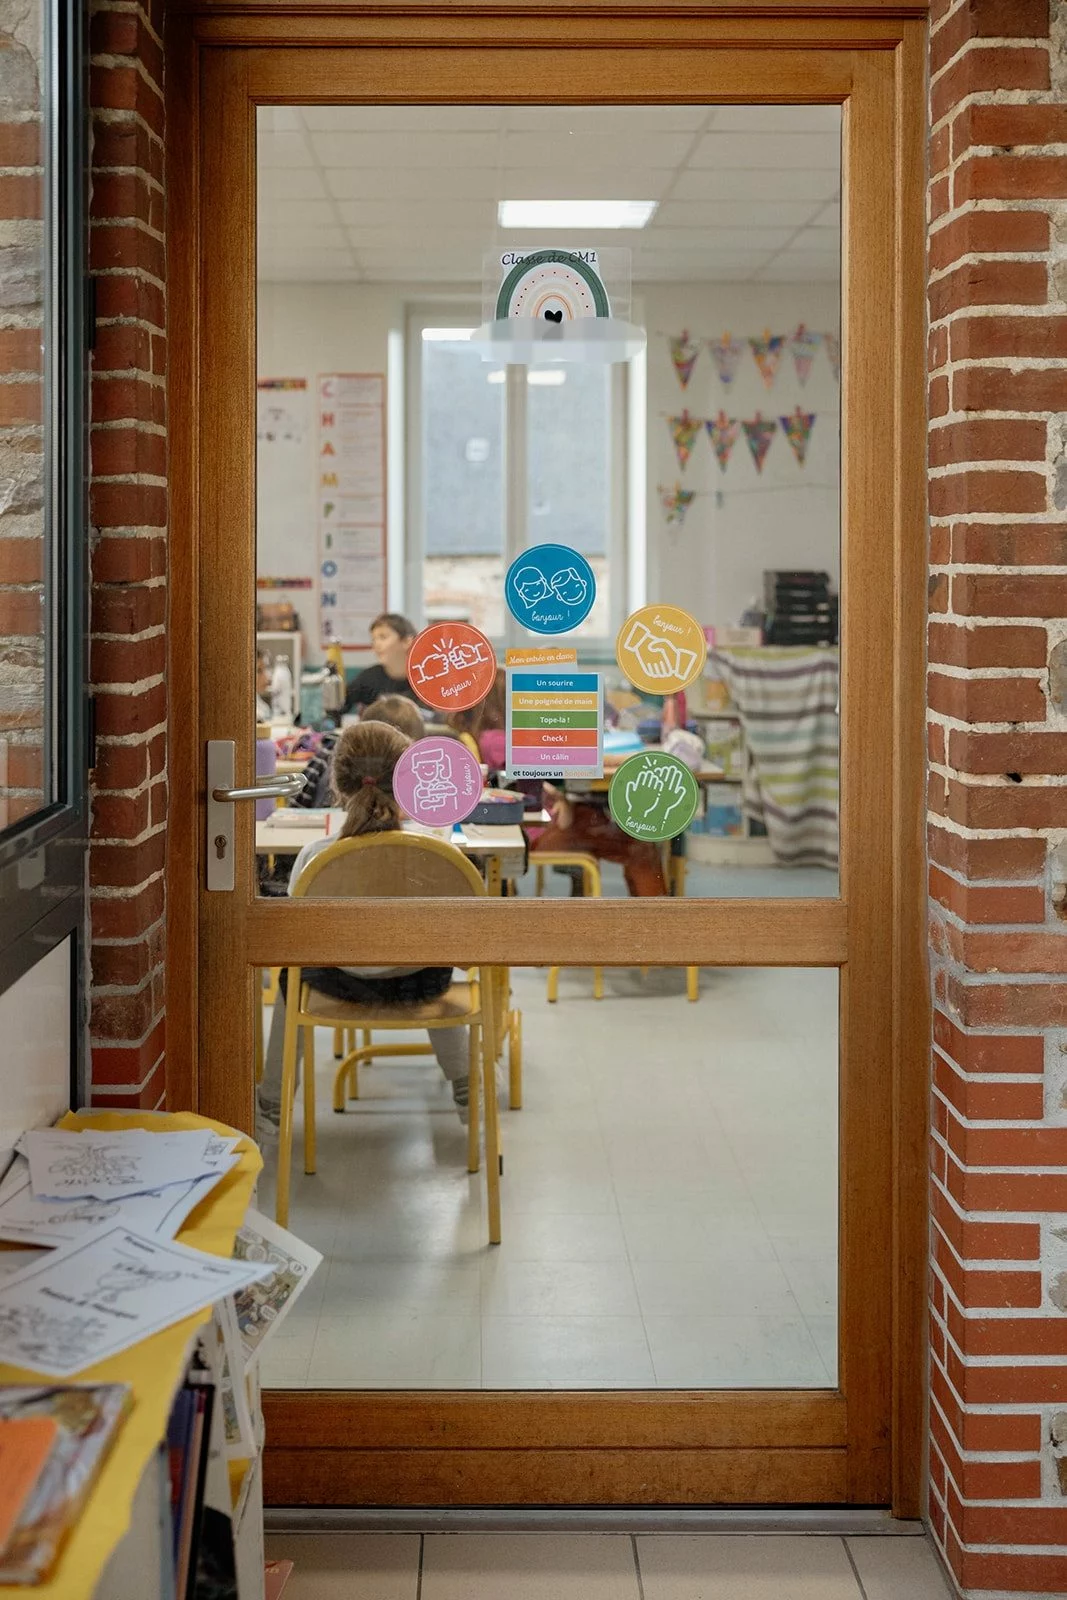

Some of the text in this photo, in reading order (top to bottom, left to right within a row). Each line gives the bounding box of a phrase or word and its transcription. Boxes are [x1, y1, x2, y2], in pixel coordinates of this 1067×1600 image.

[502, 251, 597, 265] Classe de CM1
[320, 380, 338, 636] CHAMPIONS
[532, 610, 564, 625] bonjour
[653, 614, 684, 635] bonjour
[441, 680, 472, 698] bonjour
[536, 679, 574, 687] Un sourire
[563, 697, 573, 705] de
[574, 697, 593, 705] main
[541, 734, 564, 742] Check
[540, 753, 570, 761] Un câlin
[461, 763, 476, 796] bonjour
[522, 769, 552, 778] toujours
[626, 816, 658, 833] bonjour
